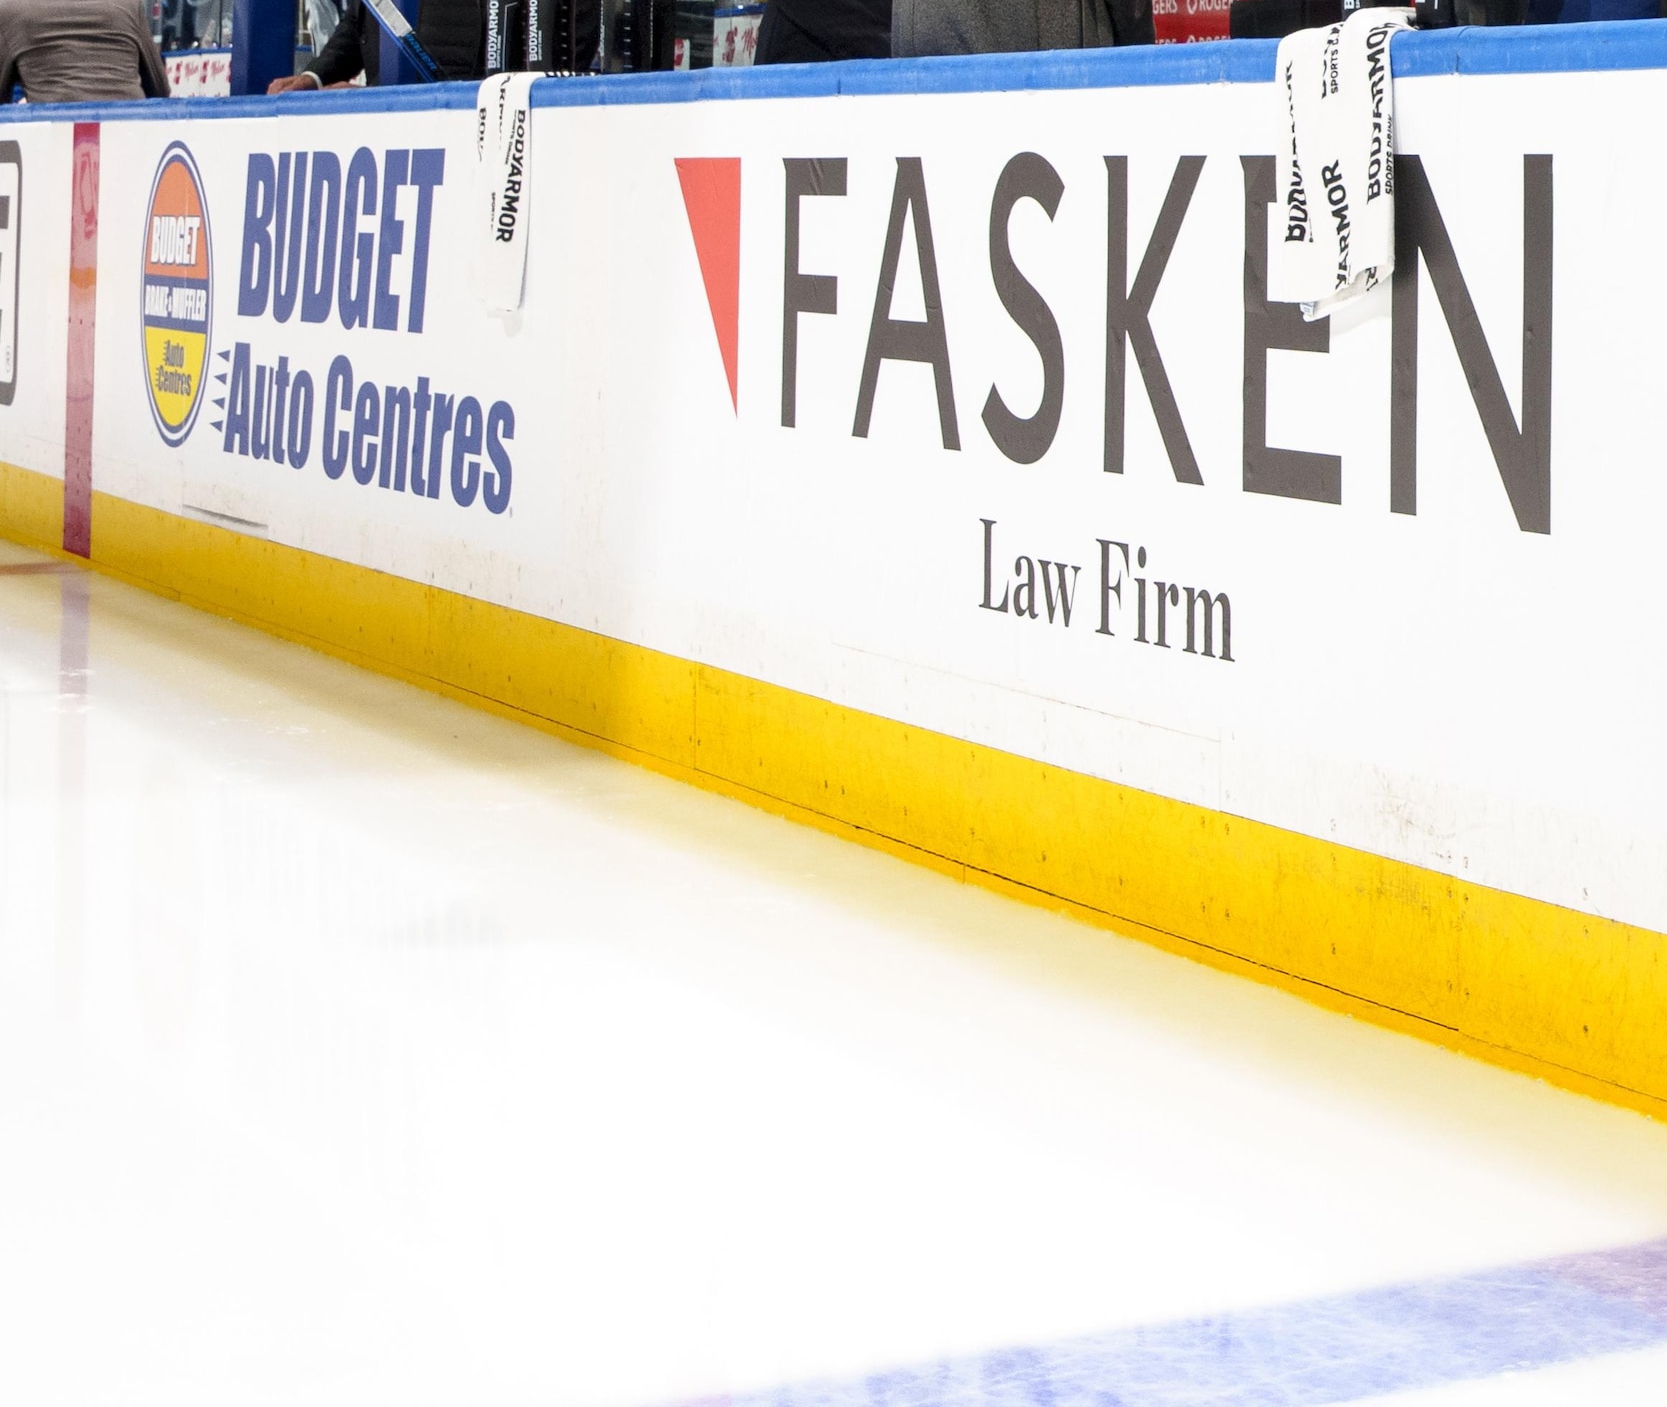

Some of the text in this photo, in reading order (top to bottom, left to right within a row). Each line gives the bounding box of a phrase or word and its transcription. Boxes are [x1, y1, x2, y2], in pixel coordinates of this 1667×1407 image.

[151, 216, 200, 265] BUDGET
[238, 146, 445, 334] BUDGET
[496, 109, 526, 243] BODYARMOR
[156, 366, 192, 397] Centres
[163, 339, 185, 368] Auto
[781, 151, 1553, 535] FASKEN
[224, 342, 515, 515] Auto Centres
[979, 519, 1235, 662] Law Firm
